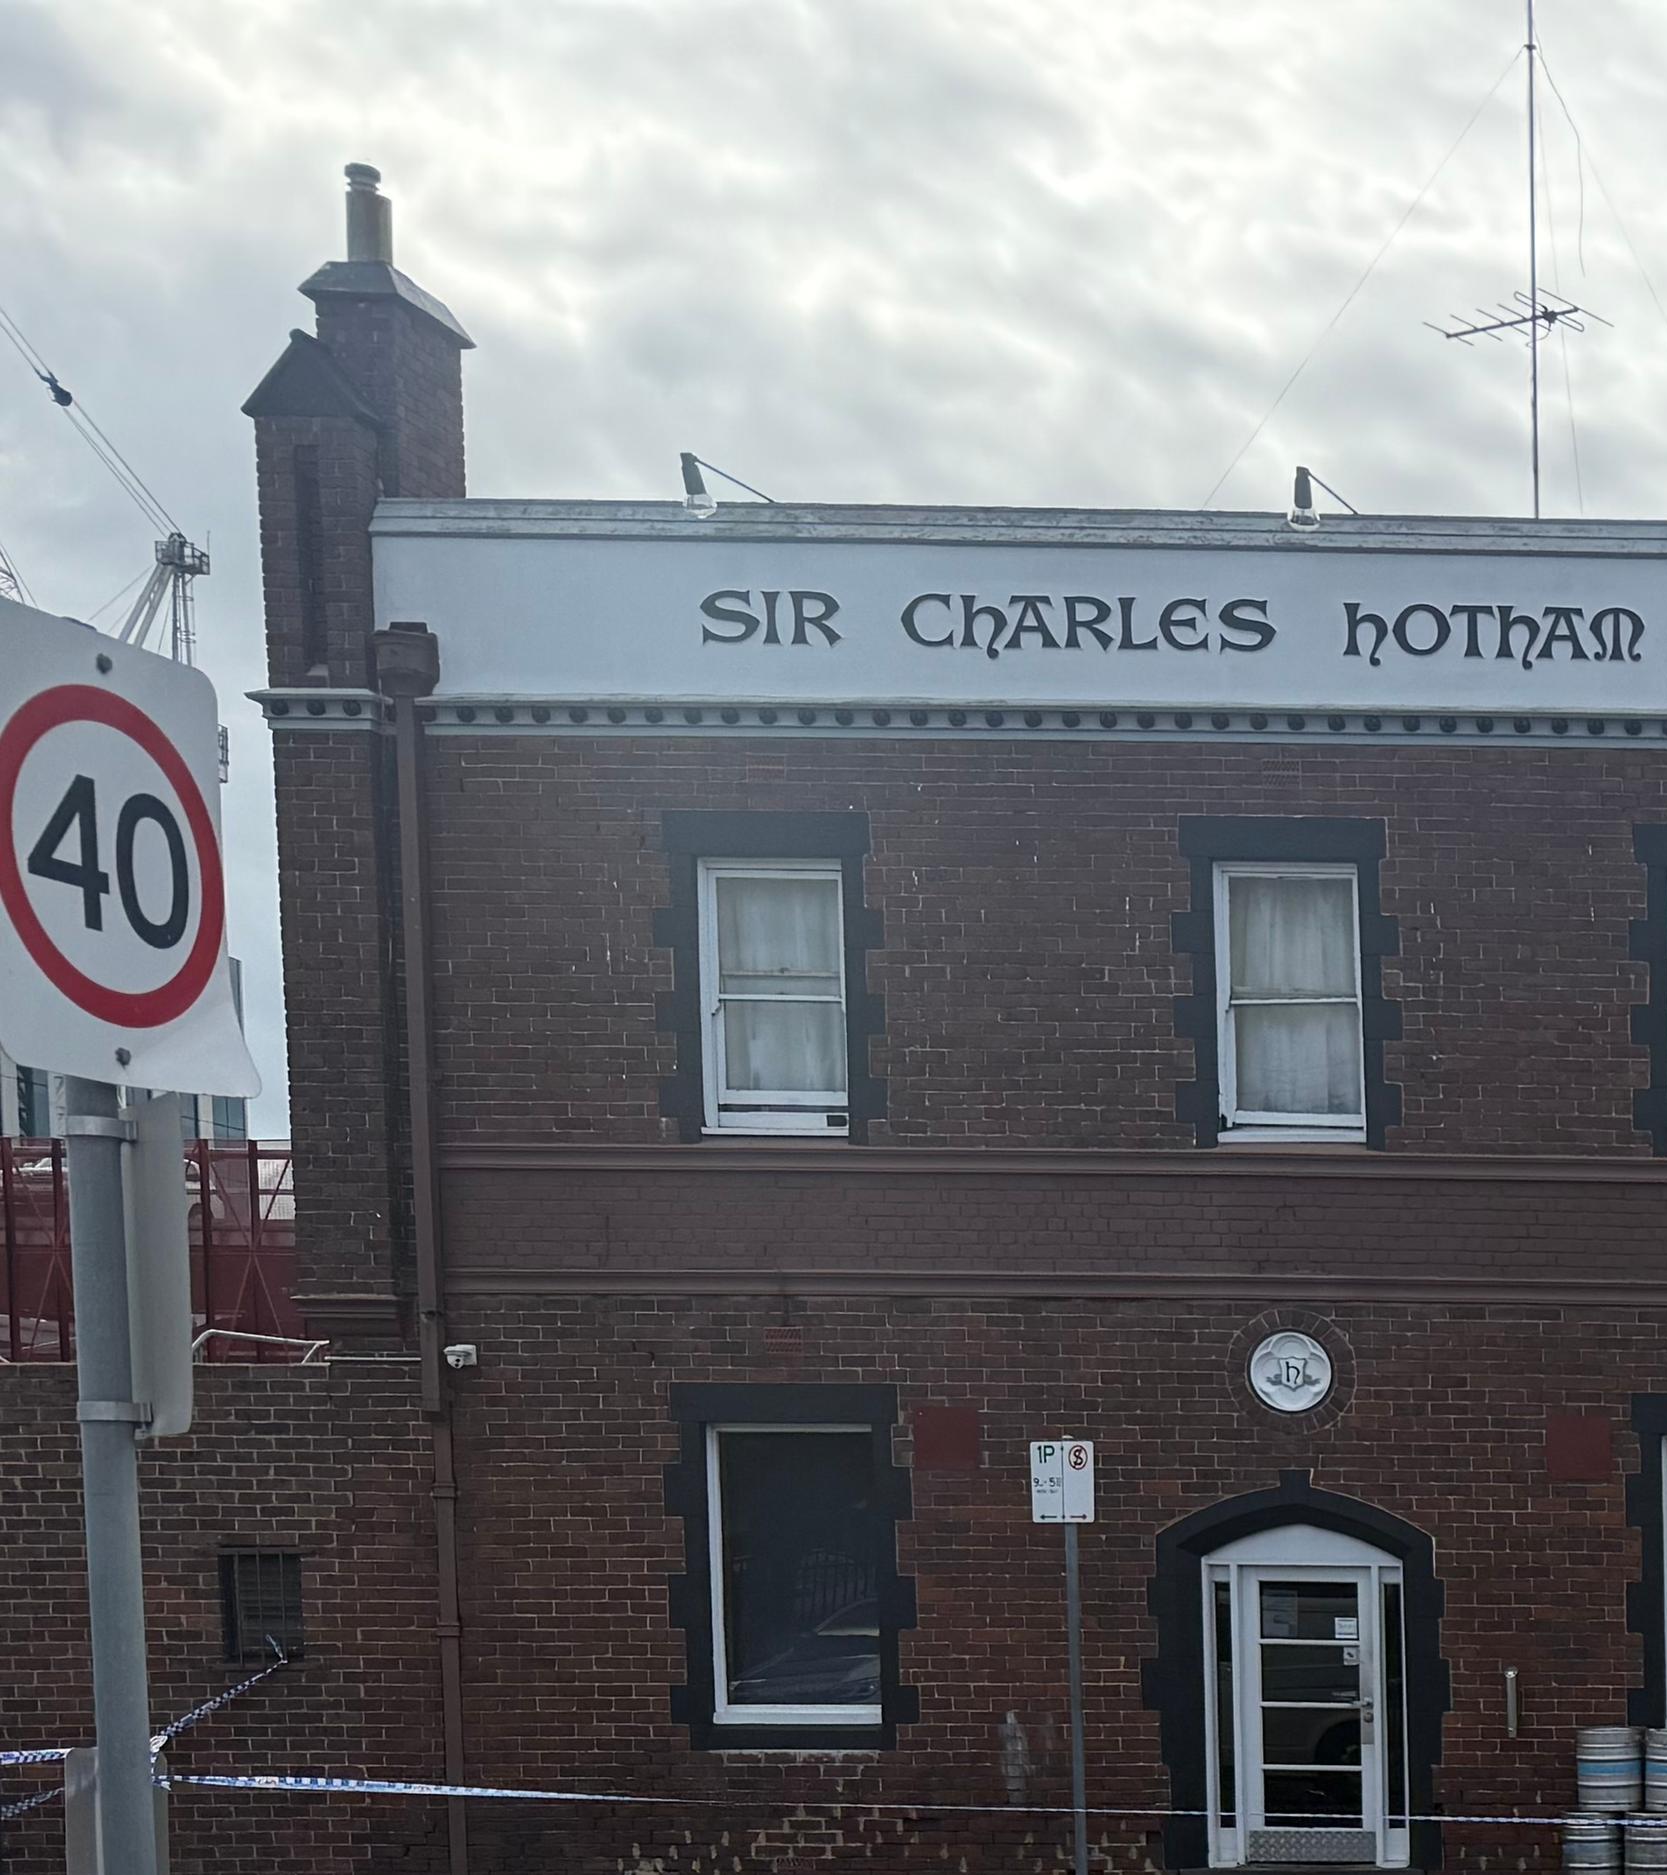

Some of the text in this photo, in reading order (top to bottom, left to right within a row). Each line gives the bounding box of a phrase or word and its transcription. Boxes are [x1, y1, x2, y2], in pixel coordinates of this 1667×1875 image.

[700, 589, 842, 648] SIR
[900, 593, 1278, 660] CHARLES
[1342, 602, 1646, 671] HOTHAM
[27, 774, 190, 950] 40
[1037, 1445, 1055, 1464] 1P
